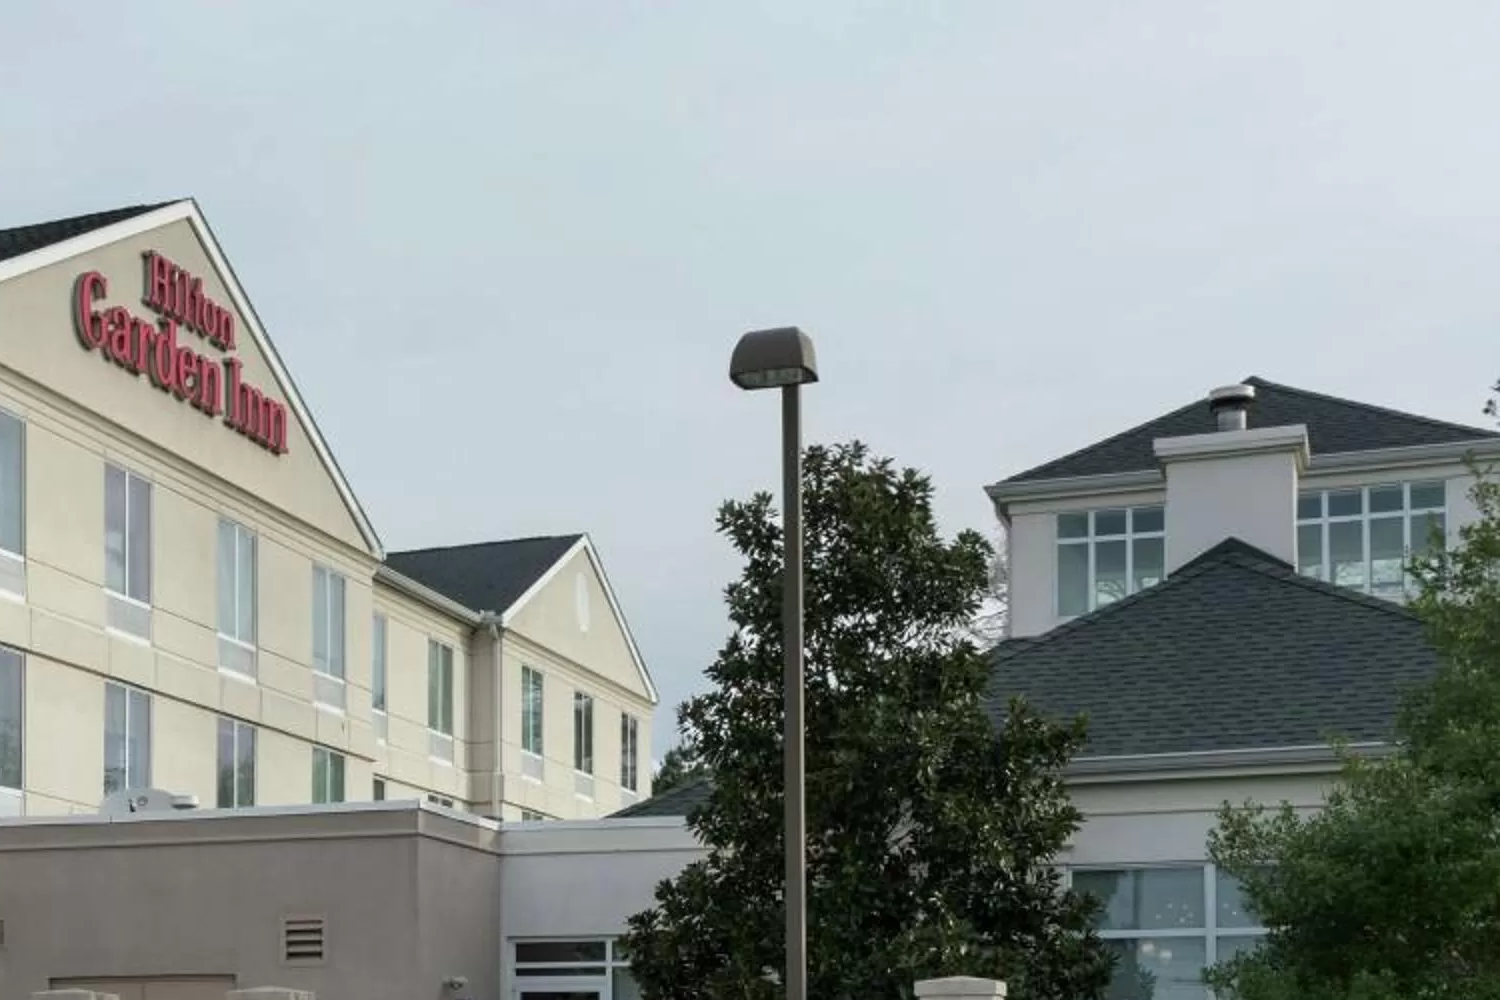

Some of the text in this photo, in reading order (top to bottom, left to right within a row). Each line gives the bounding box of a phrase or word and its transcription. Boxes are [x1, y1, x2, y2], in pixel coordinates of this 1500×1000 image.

[72, 270, 290, 456] Garden Inn
[141, 250, 237, 351] Hilton
